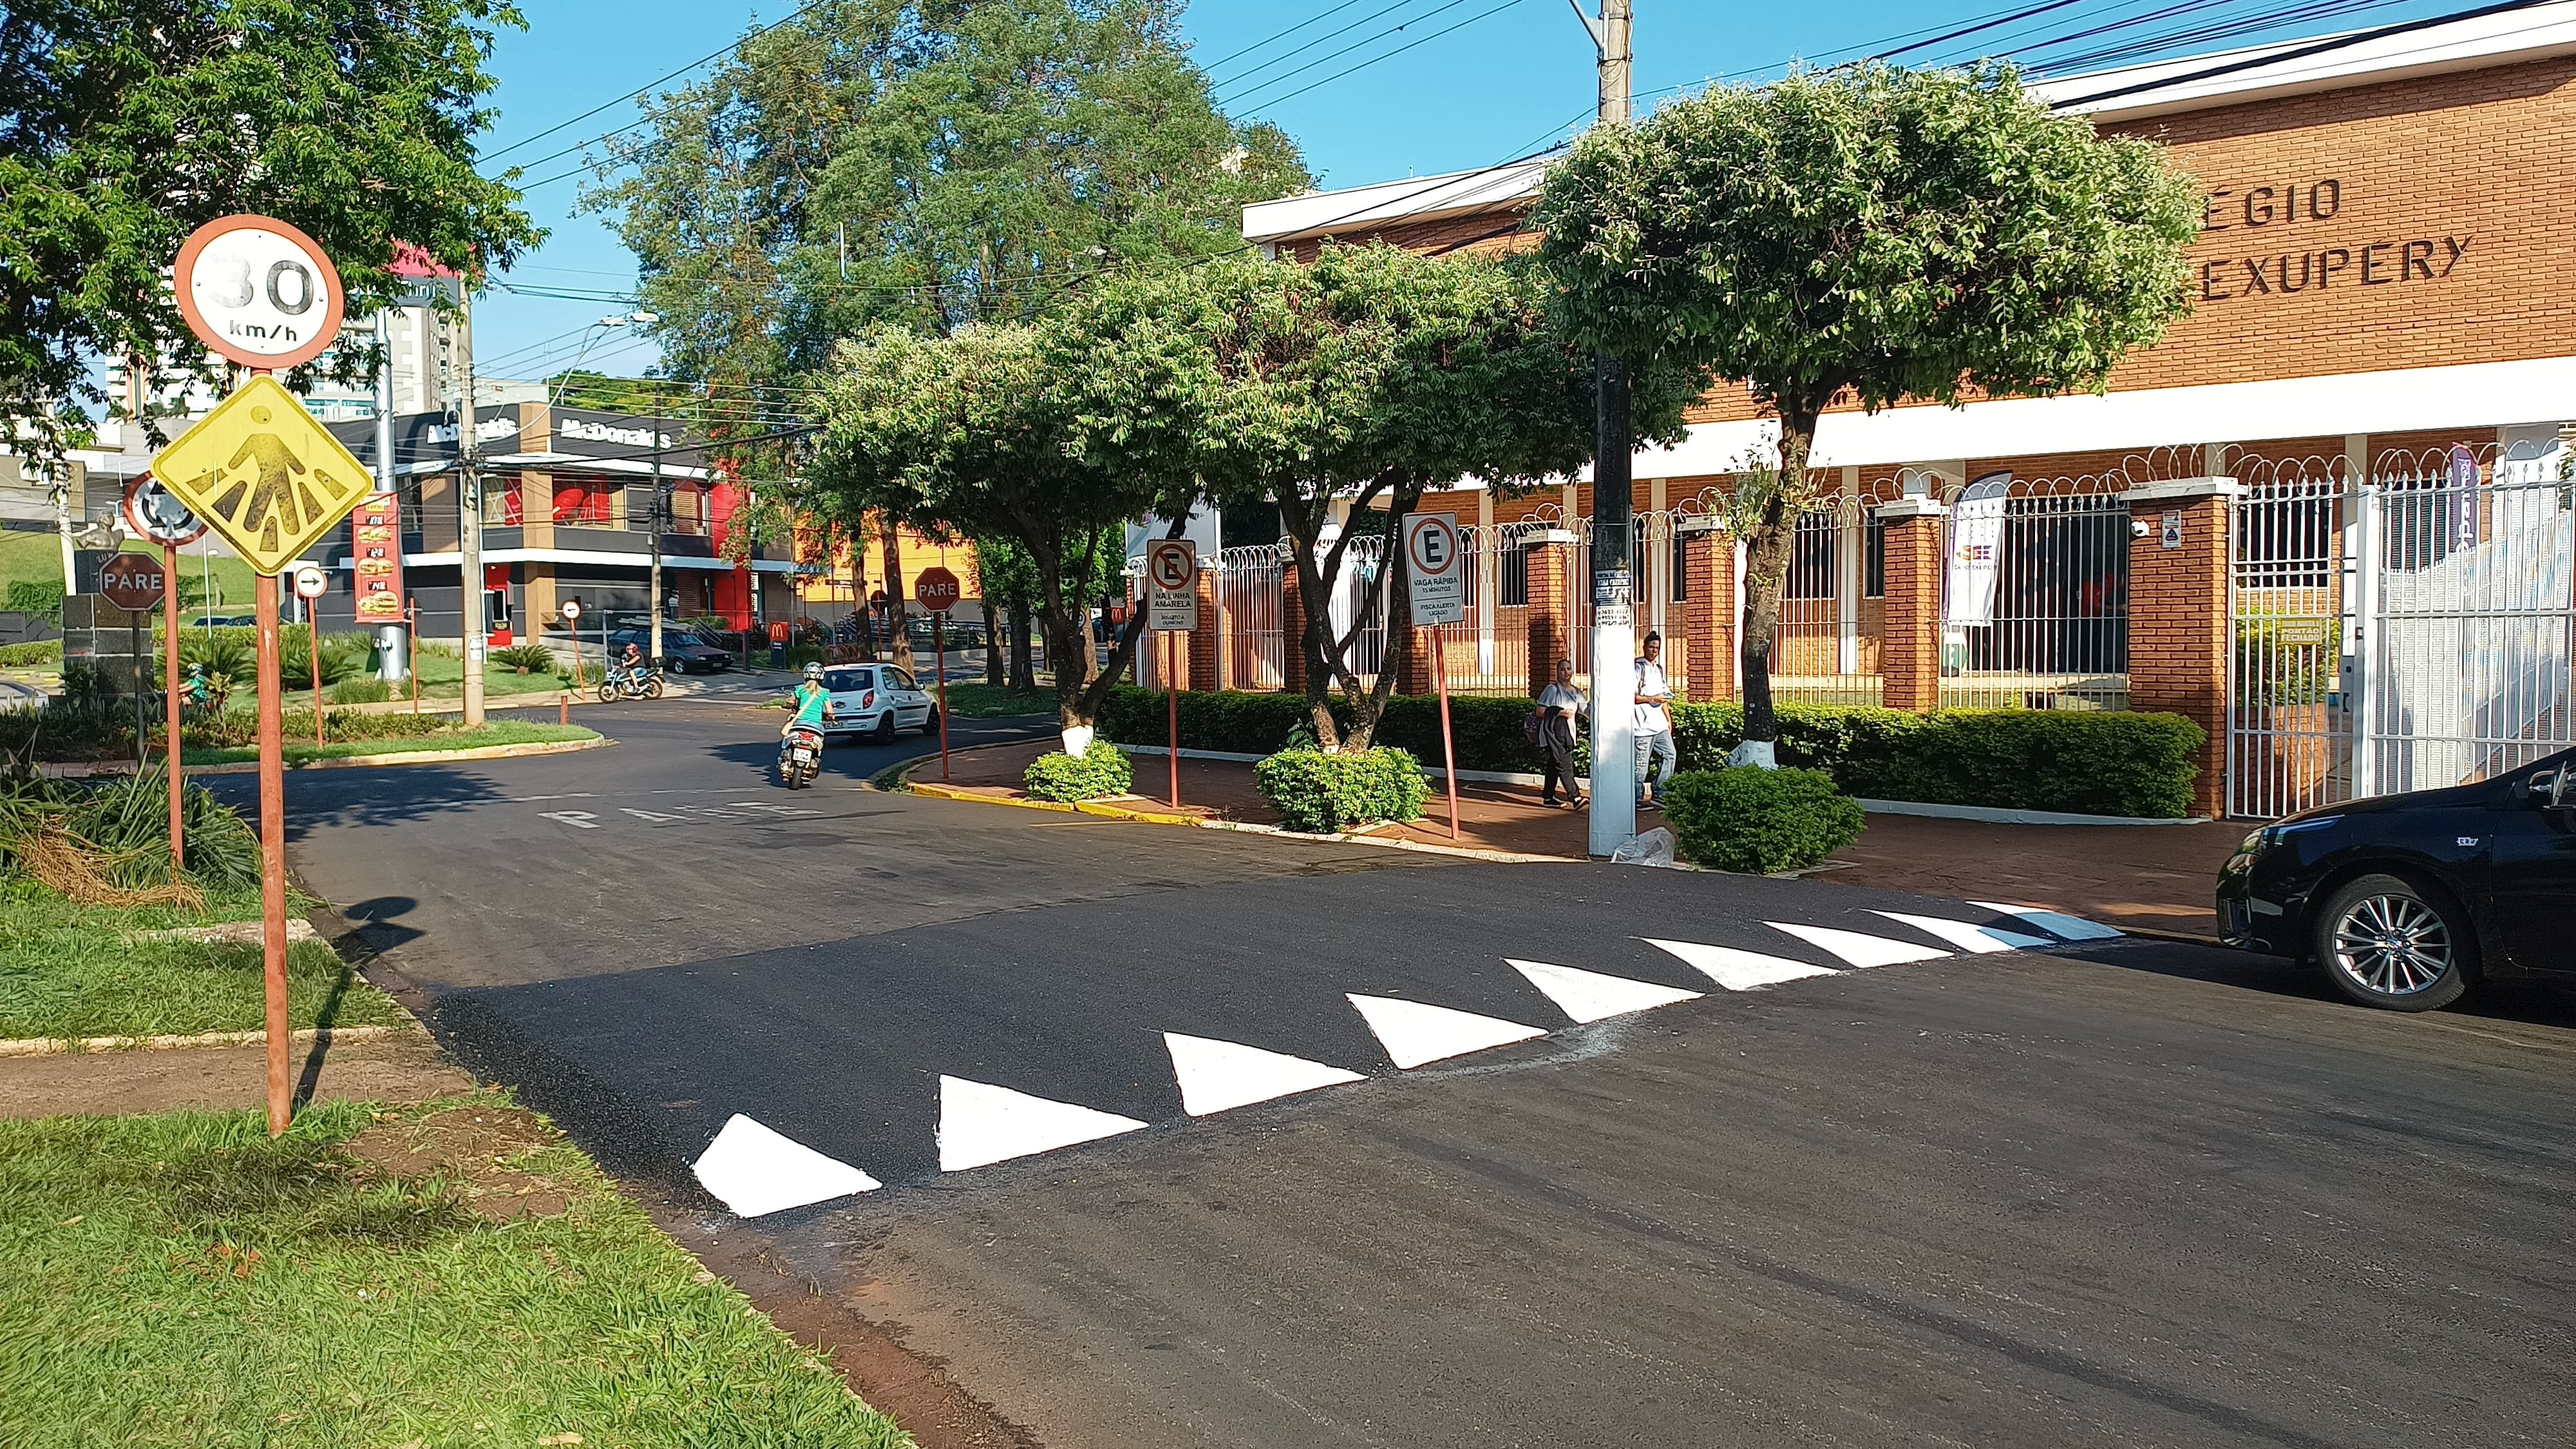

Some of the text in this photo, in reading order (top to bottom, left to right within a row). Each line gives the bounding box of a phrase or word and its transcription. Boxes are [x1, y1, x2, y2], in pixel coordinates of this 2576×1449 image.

[207, 252, 314, 316] 30
[229, 319, 298, 342] km/h
[560, 418, 672, 450] McDonalds
[1423, 529, 1443, 563] E
[104, 573, 163, 590] PARE
[918, 583, 957, 598] PARE
[2280, 634, 2320, 642] FECHADO
